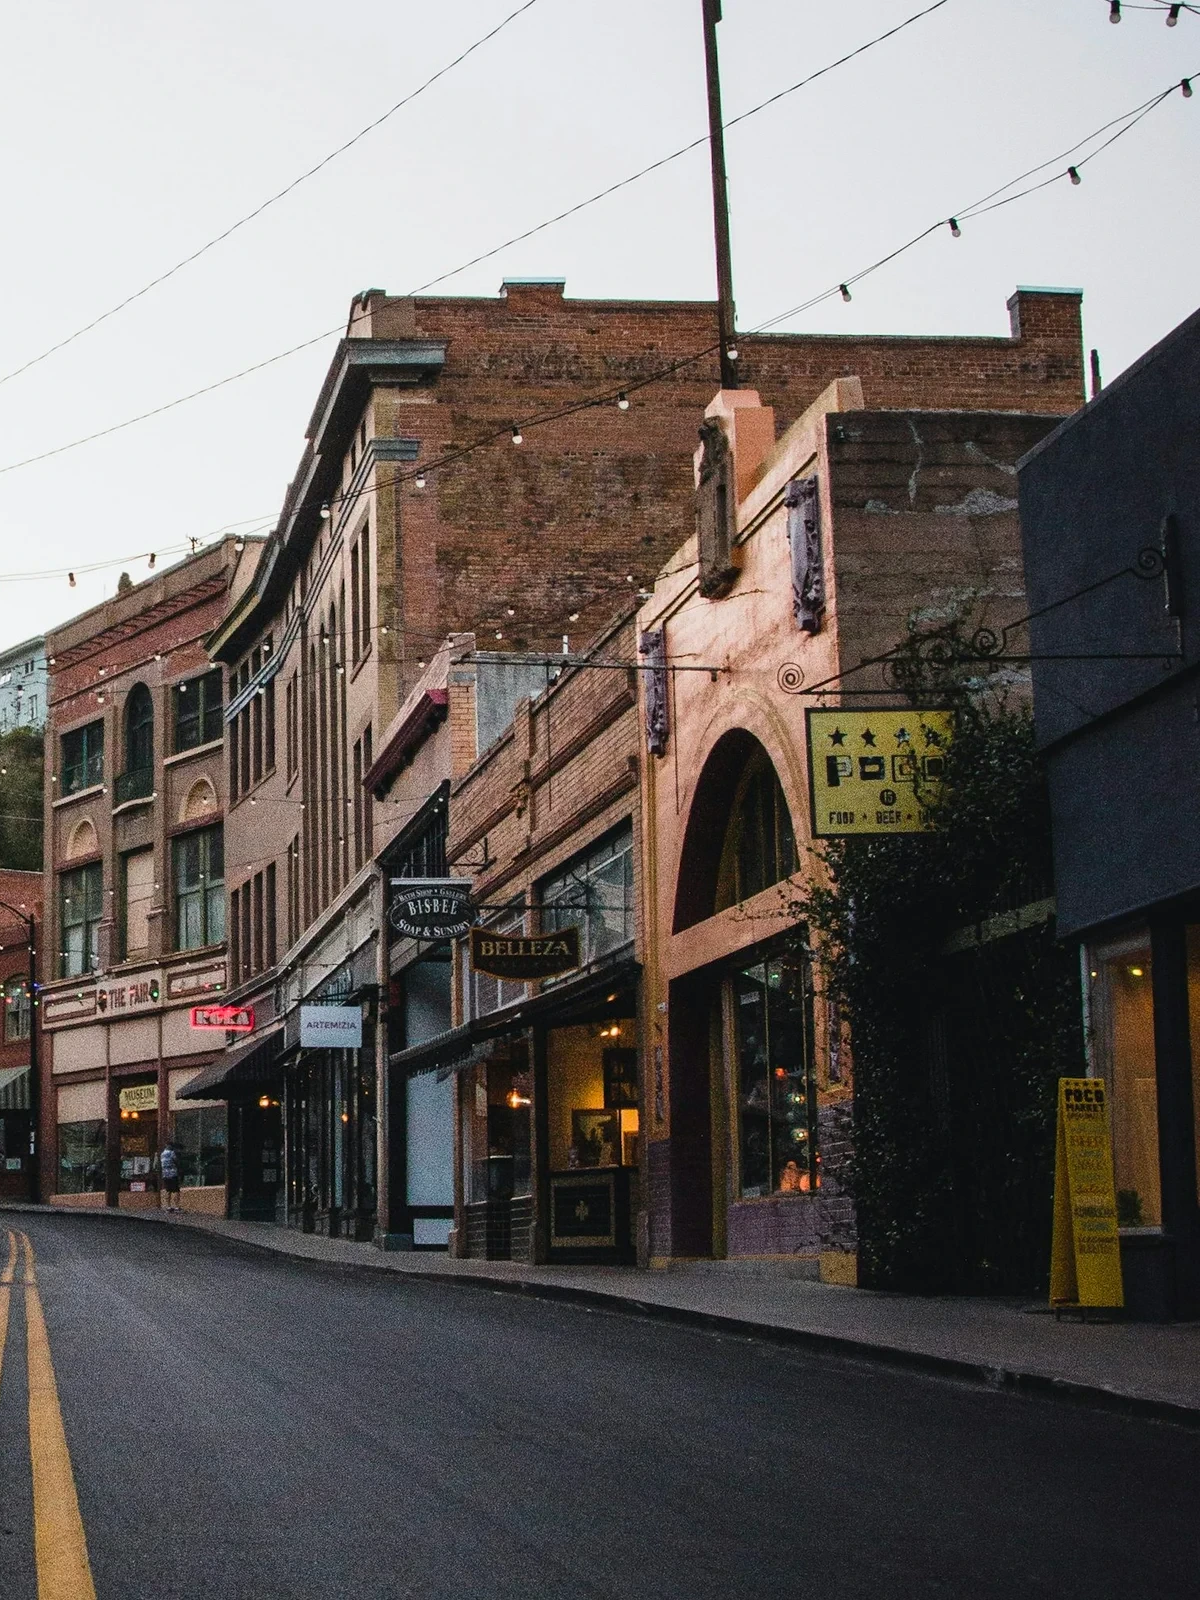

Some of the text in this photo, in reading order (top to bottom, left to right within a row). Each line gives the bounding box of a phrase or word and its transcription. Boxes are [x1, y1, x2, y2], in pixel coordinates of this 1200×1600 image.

[829, 811, 855, 824] FOOD
[876, 810, 901, 824] BEER
[398, 918, 422, 936] SOAP
[422, 926, 431, 937] &
[433, 919, 471, 937] SUNDRY
[480, 940, 572, 956] BELLEZA
[109, 982, 149, 1009] THE FAIR
[306, 1021, 357, 1029] ARTEMIZIA
[124, 1086, 155, 1101] MUSEUM
[1065, 1088, 1104, 1102] POCO
[1066, 1103, 1104, 1112] MARKET
